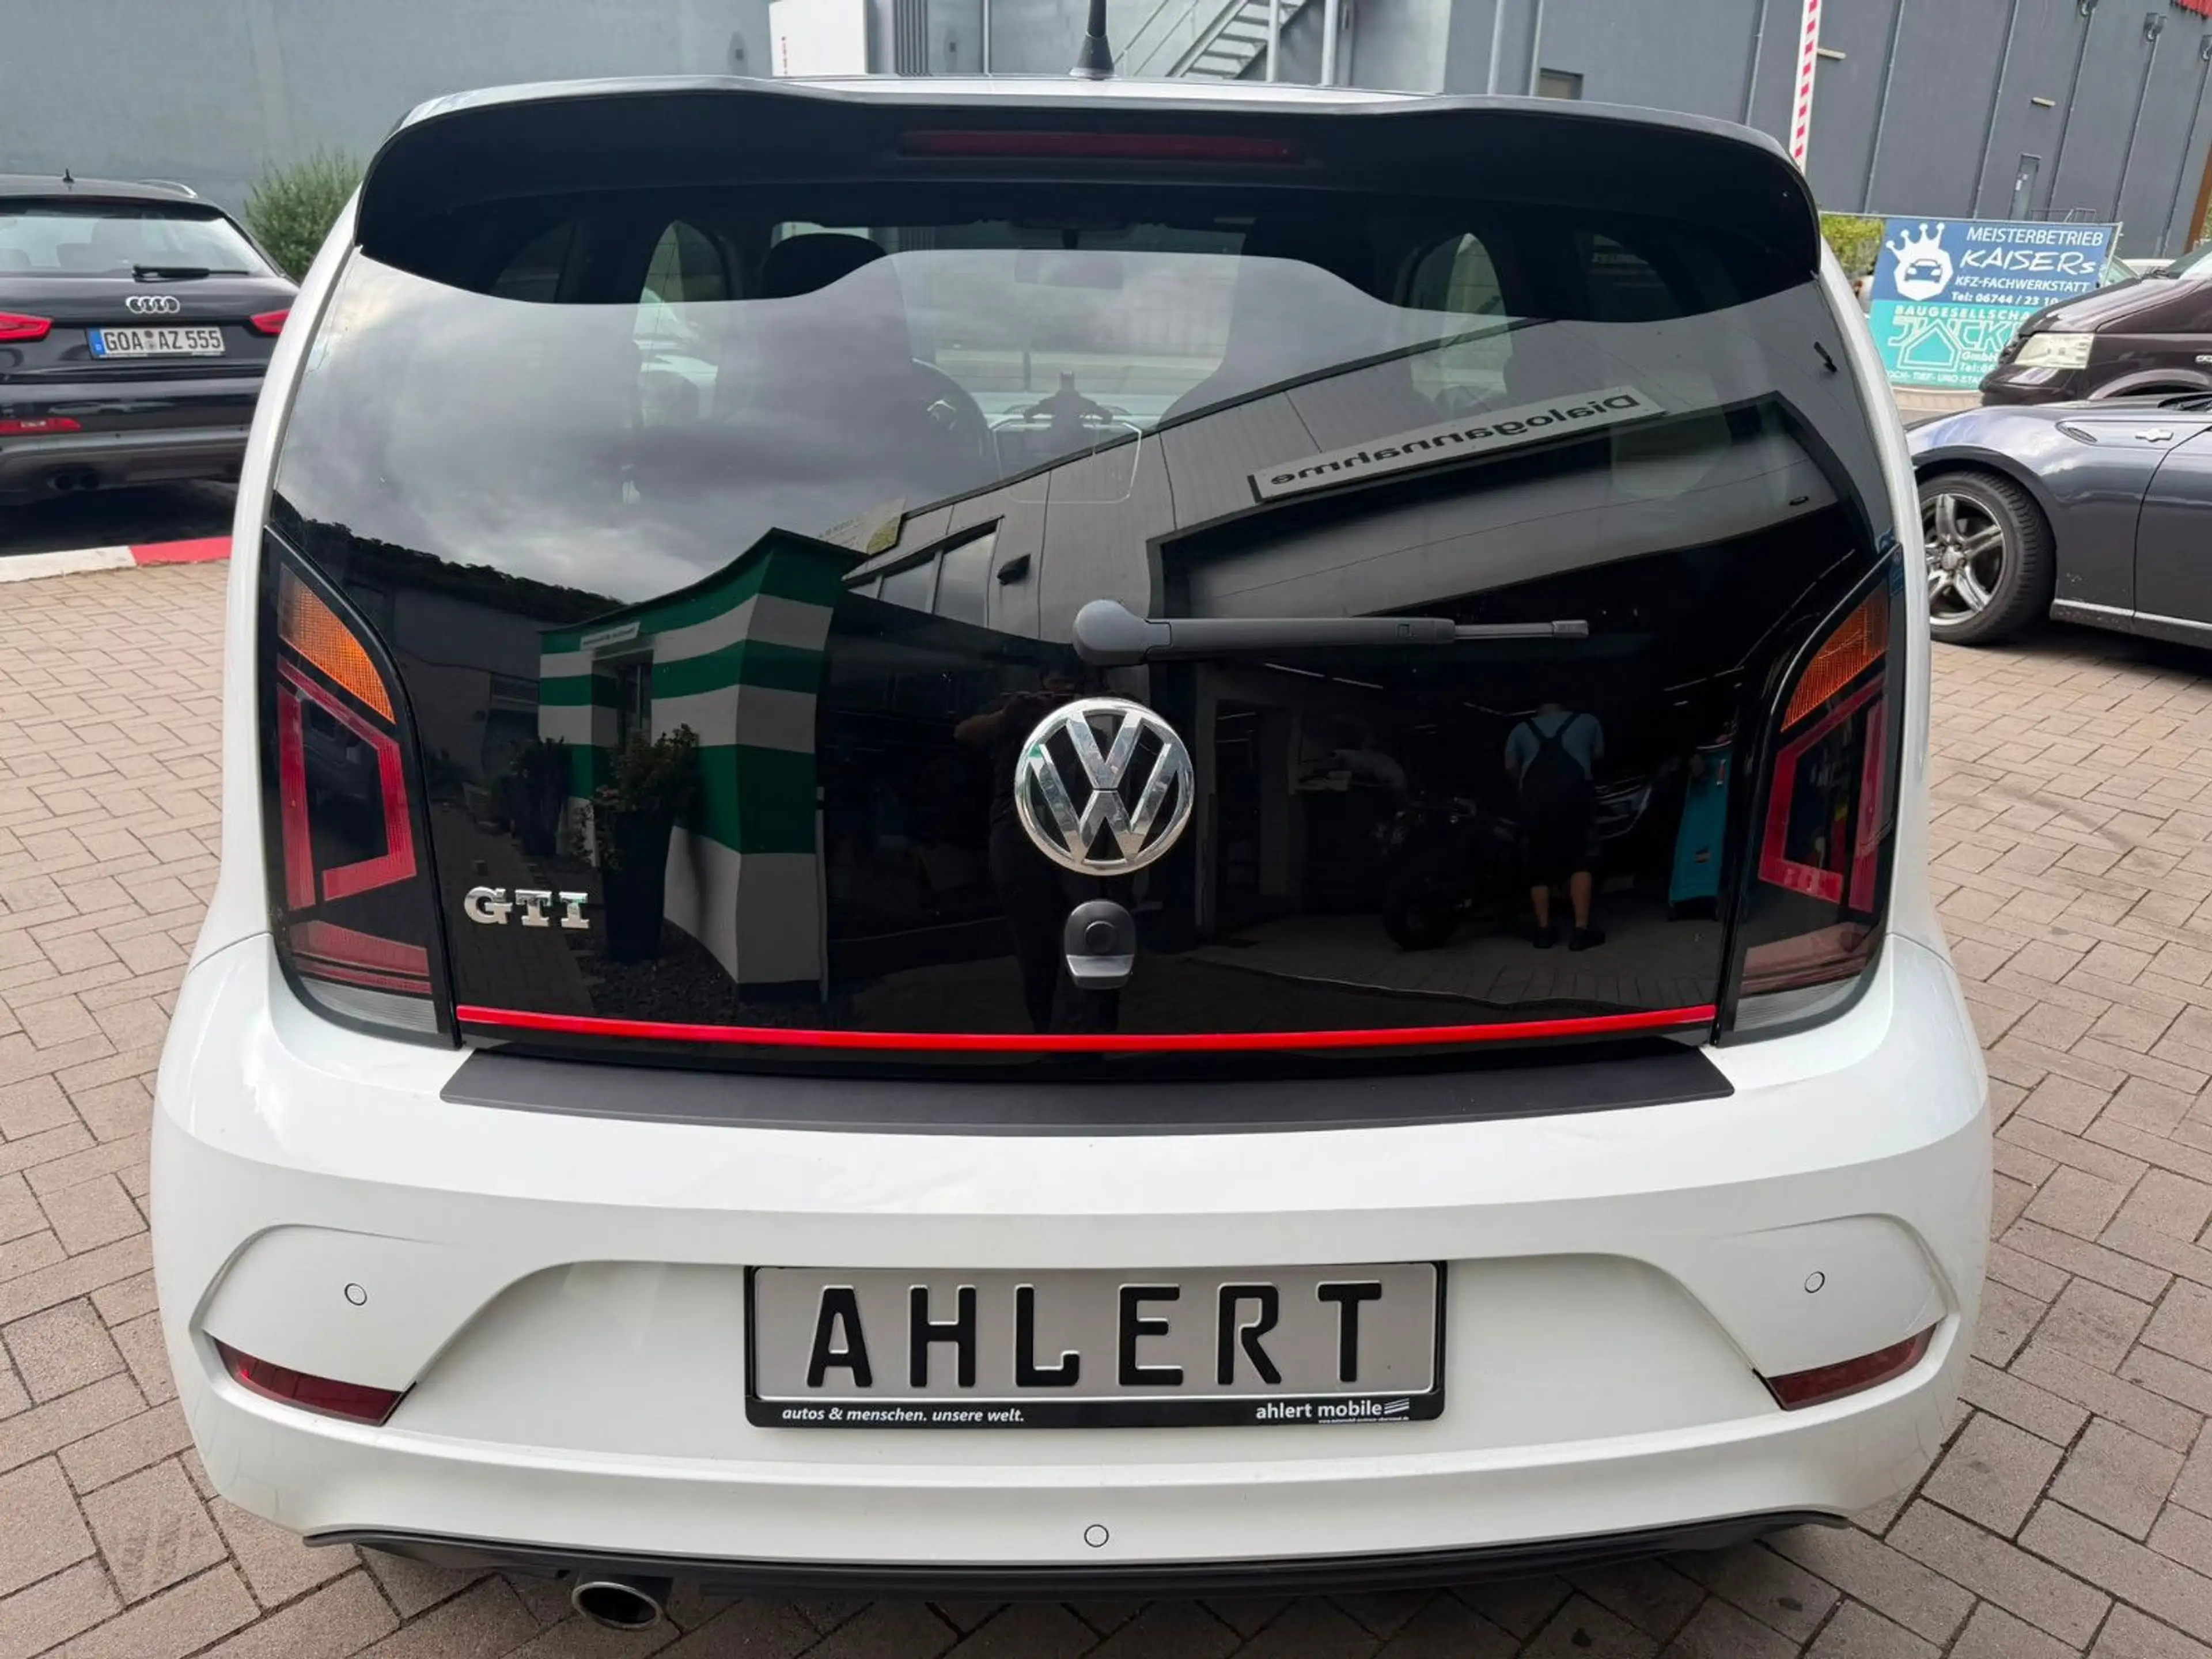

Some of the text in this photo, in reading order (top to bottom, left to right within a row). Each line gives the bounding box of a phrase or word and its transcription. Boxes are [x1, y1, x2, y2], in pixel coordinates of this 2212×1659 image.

[1967, 226, 2104, 247] MEISTERBETRIEB
[1955, 275, 2090, 293] KFZ-FACHWERKSTATT
[1952, 291, 1974, 302] Tel:
[1976, 293, 2014, 304] 06744
[2024, 296, 2039, 305] 23
[104, 331, 143, 351] GOA
[159, 331, 183, 350] AZ
[185, 330, 221, 349] 555
[464, 886, 589, 929] GTI
[806, 1281, 1382, 1388] AHLERT
[782, 1407, 1024, 1422] autos & menschen. unsere welt.
[1256, 1400, 1382, 1419] ahlert mobile
